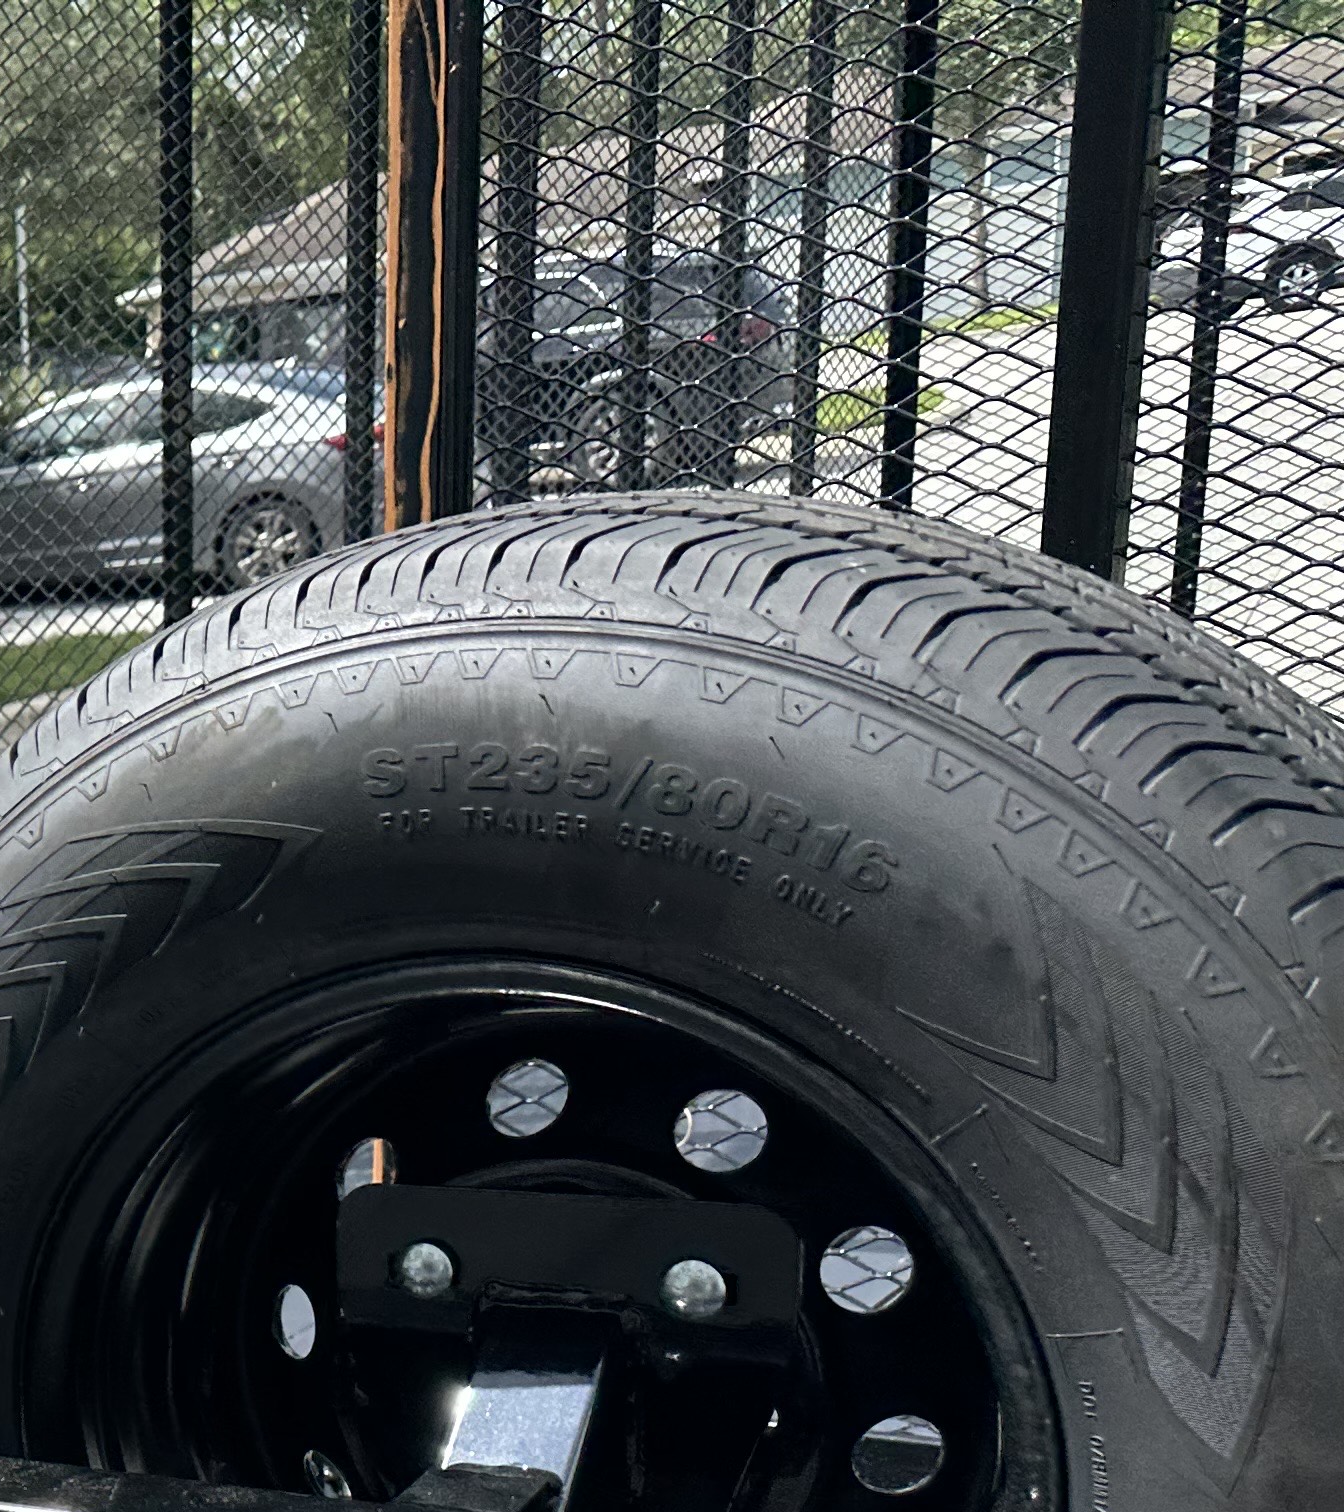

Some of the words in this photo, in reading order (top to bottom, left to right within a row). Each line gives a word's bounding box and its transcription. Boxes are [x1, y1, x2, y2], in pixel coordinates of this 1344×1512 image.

[361, 741, 900, 894] ST235/80R16
[459, 805, 589, 842] TRAILER
[613, 822, 752, 884] SERVICE
[775, 874, 854, 928] ONLY
